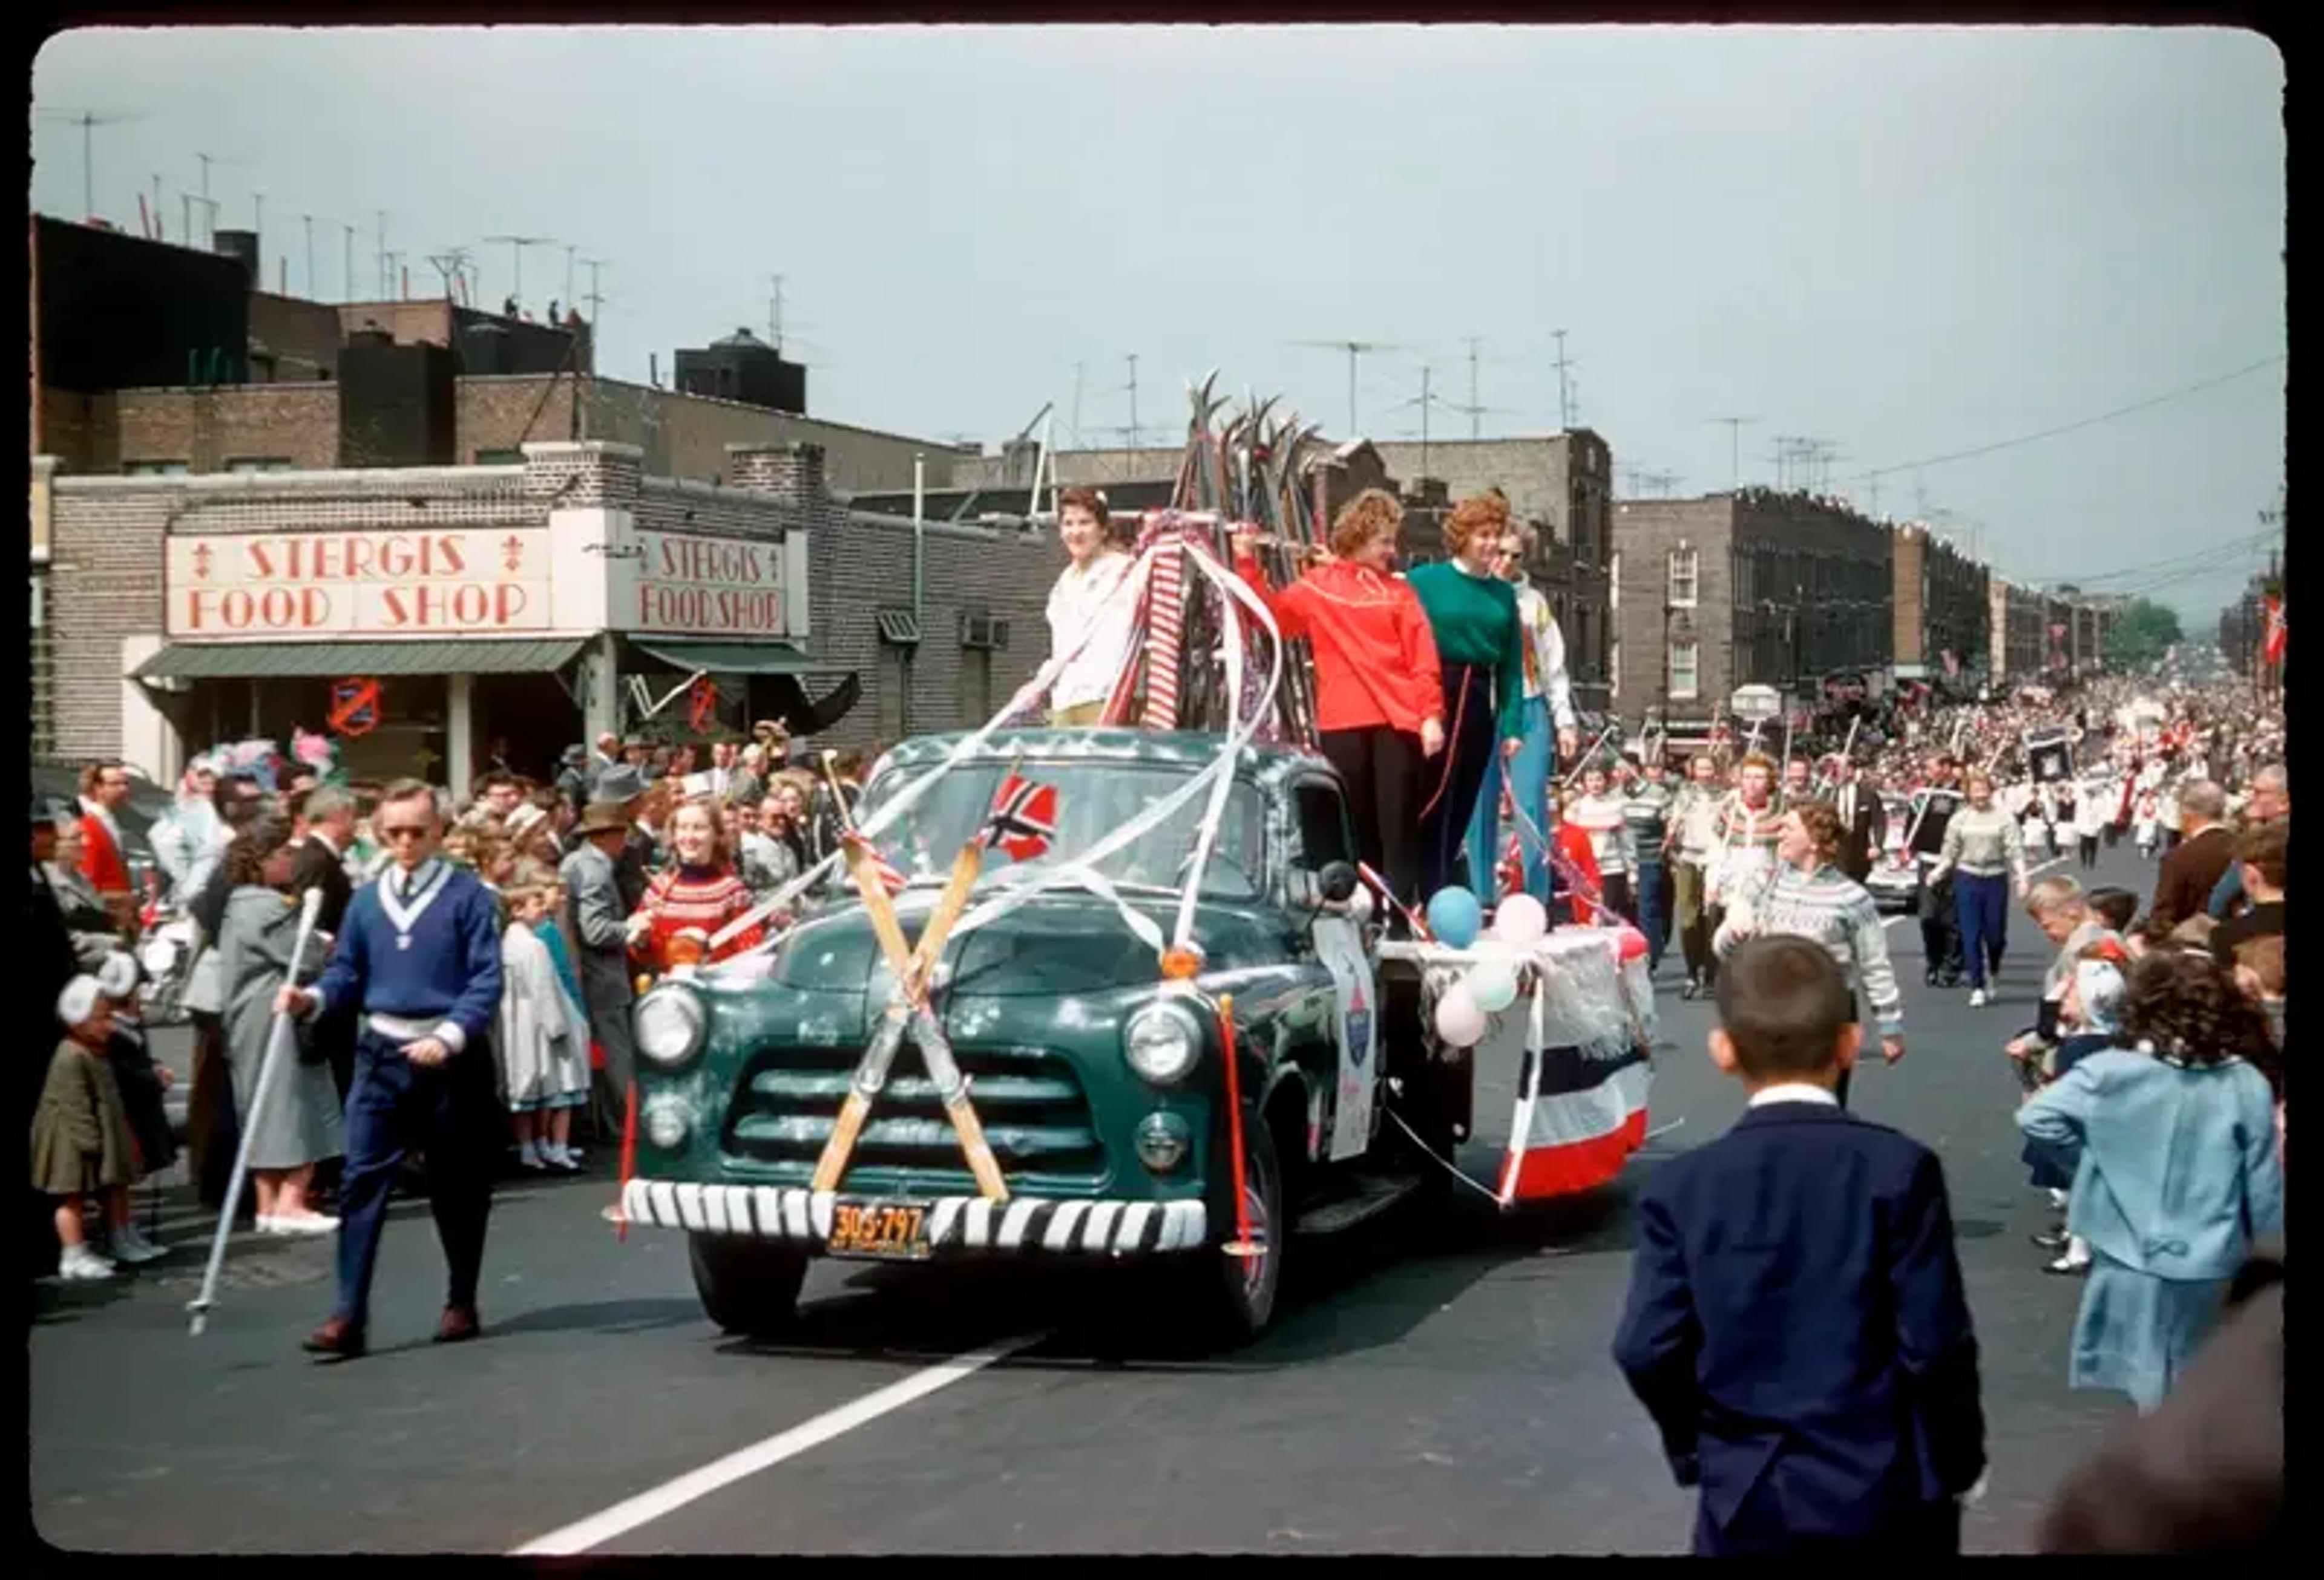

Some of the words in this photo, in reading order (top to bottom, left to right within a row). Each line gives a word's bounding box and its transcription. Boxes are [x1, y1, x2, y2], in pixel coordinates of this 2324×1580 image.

[247, 535, 466, 579] STERGIS
[661, 537, 762, 583] STERGIS
[189, 588, 330, 629] FOOD
[381, 583, 527, 626] SHOP
[640, 583, 712, 628] FOOD
[718, 589, 780, 630] SHOP
